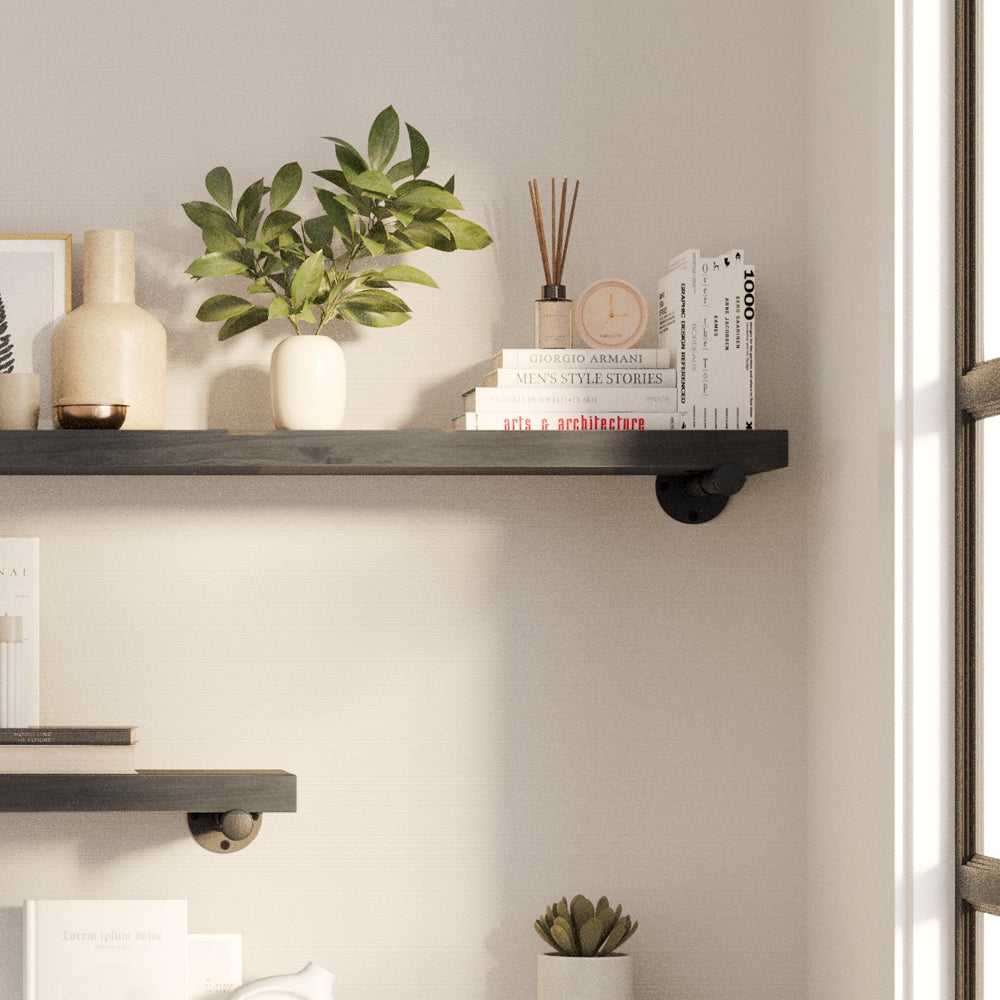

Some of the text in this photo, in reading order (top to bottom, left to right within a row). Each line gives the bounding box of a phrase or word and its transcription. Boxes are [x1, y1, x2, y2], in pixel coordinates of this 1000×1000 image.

[744, 269, 755, 320] 1000
[529, 354, 643, 364] GIORGIO ARMANI
[516, 372, 663, 384] MEN'S STYLE STORIES
[504, 416, 531, 430] arts
[558, 415, 645, 430] architecture
[63, 930, 96, 941] Lorem
